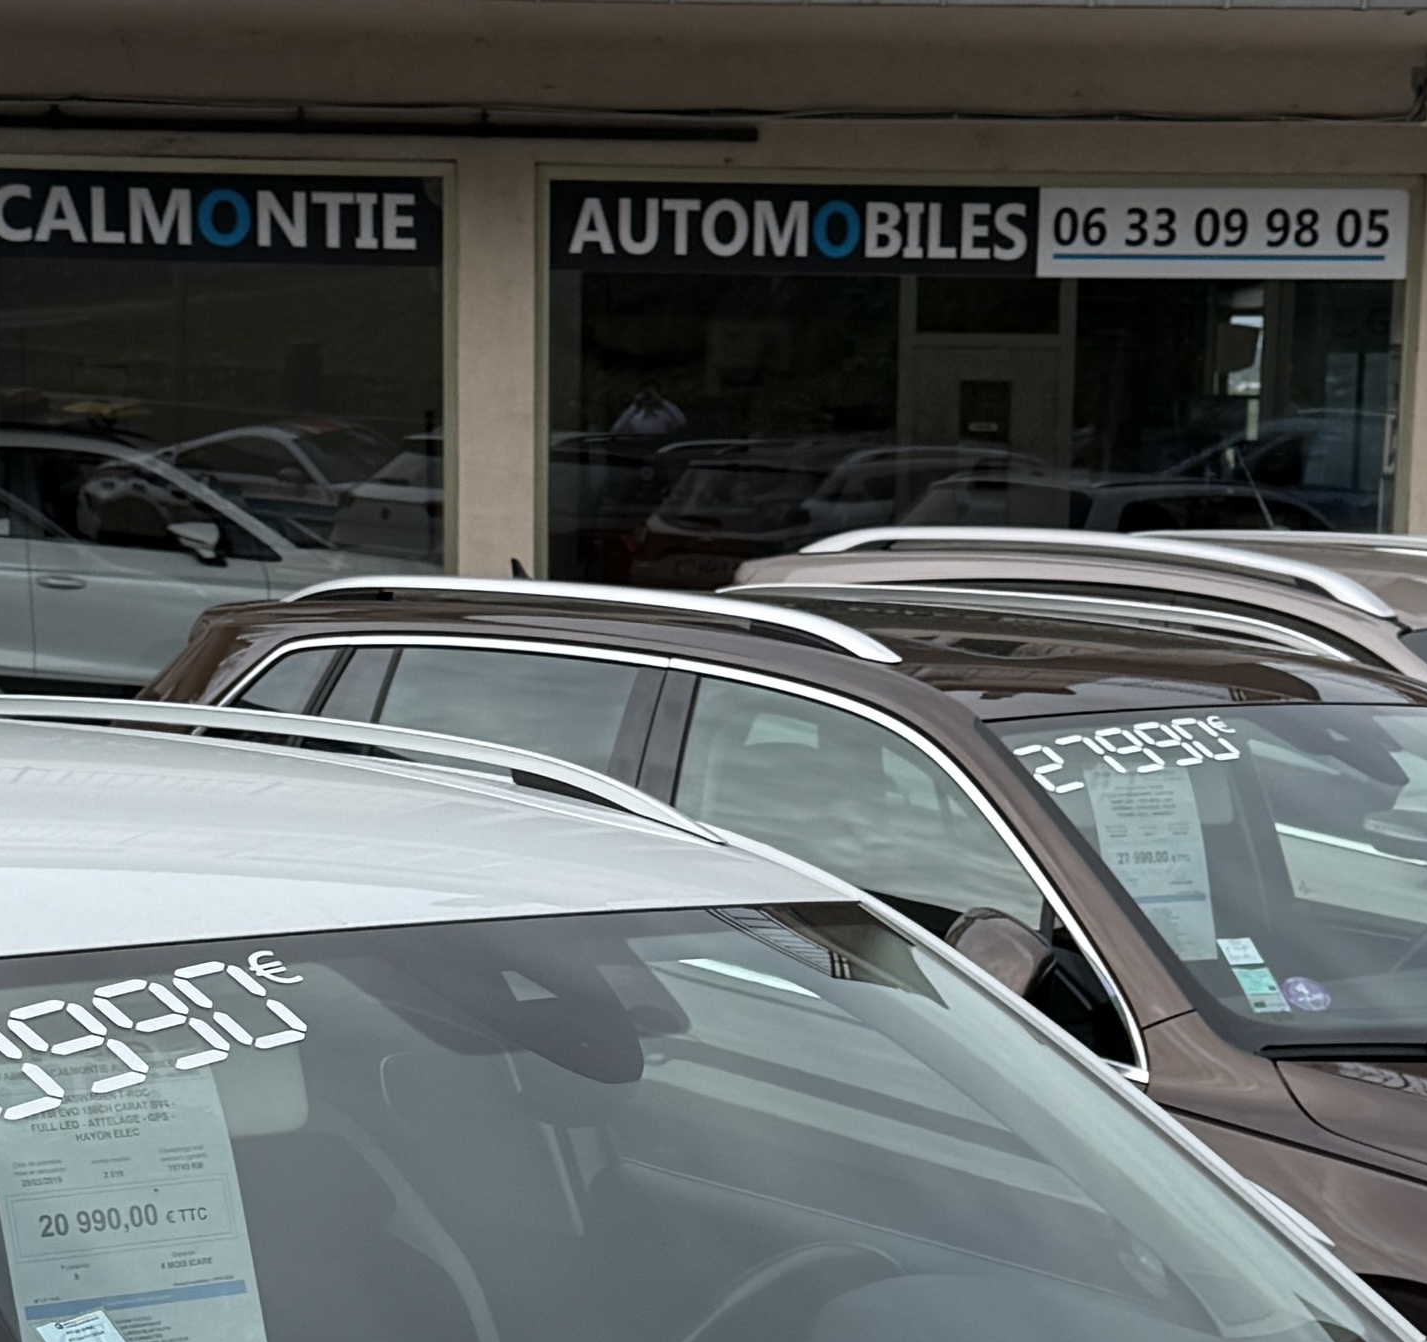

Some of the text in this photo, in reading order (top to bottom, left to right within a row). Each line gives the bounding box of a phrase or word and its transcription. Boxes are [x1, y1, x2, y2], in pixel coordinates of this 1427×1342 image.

[569, 198, 1029, 262] AUTOMOBILES
[1052, 206, 1391, 249] 06 33 09 98 05
[38, 1212, 70, 1238] 20
[76, 1203, 158, 1234] 990,00
[178, 1206, 208, 1223] TTC
